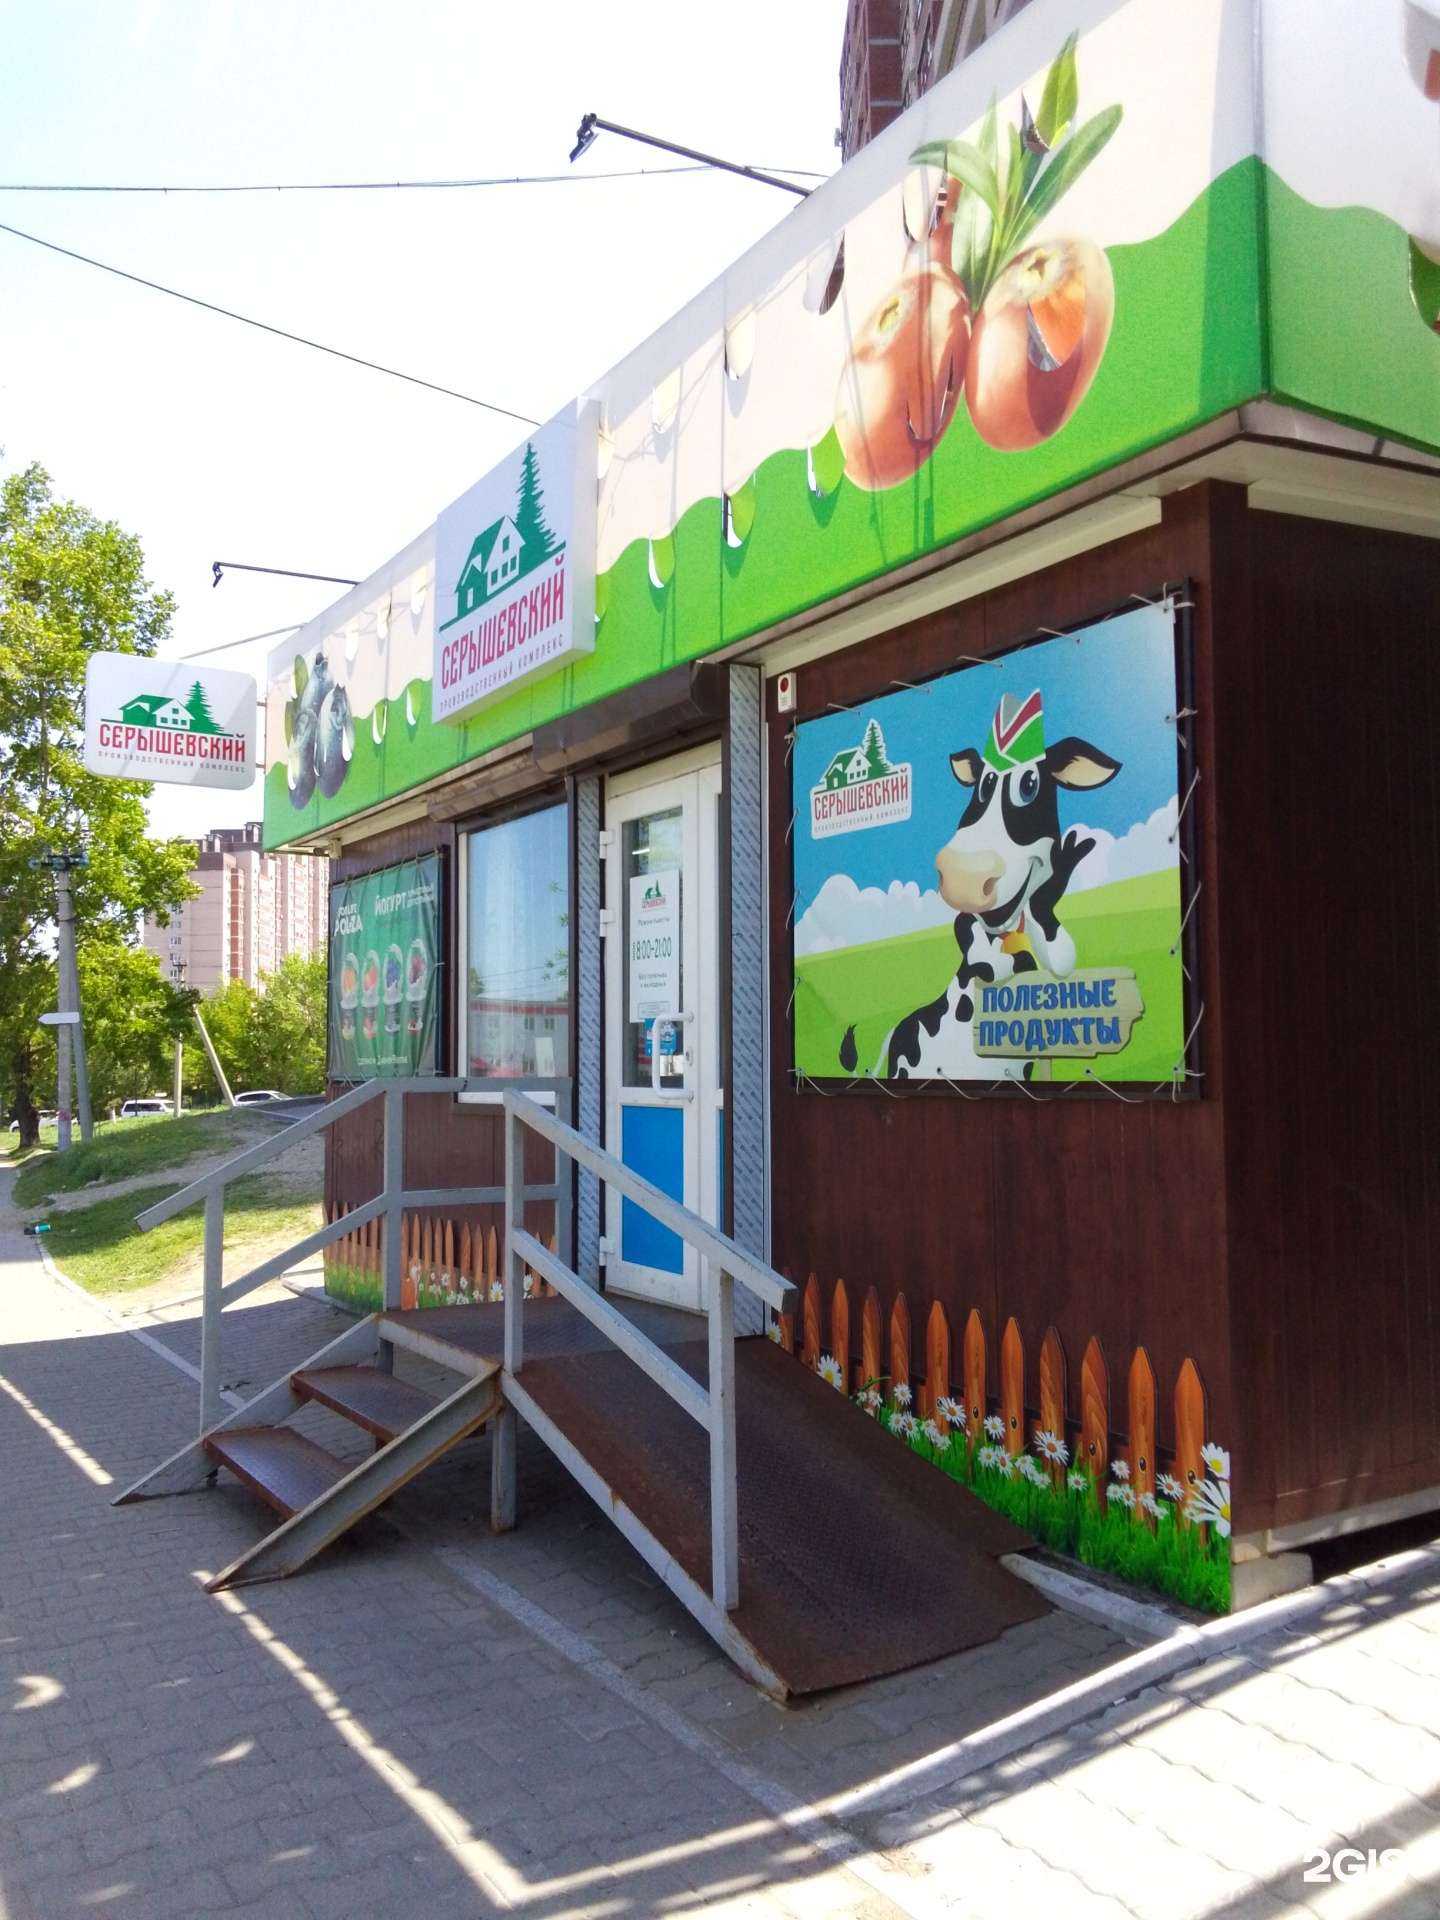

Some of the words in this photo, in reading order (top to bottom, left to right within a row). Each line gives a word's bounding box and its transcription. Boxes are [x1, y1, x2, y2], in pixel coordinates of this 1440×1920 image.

[441, 552, 565, 690] СЕРЫШЕВСКИЙ
[518, 633, 564, 669] КОМПЛЕКС
[99, 723, 246, 763] СЕРЫШЕВСКИЙ
[814, 767, 909, 821] СЕРЫШЕВСКИЙ
[374, 892, 407, 917] ЙОГУРТ
[982, 979, 1118, 1013] ПОЛЕЗНЫЕ
[979, 1016, 1122, 1052] ПРОДУКТЫ
